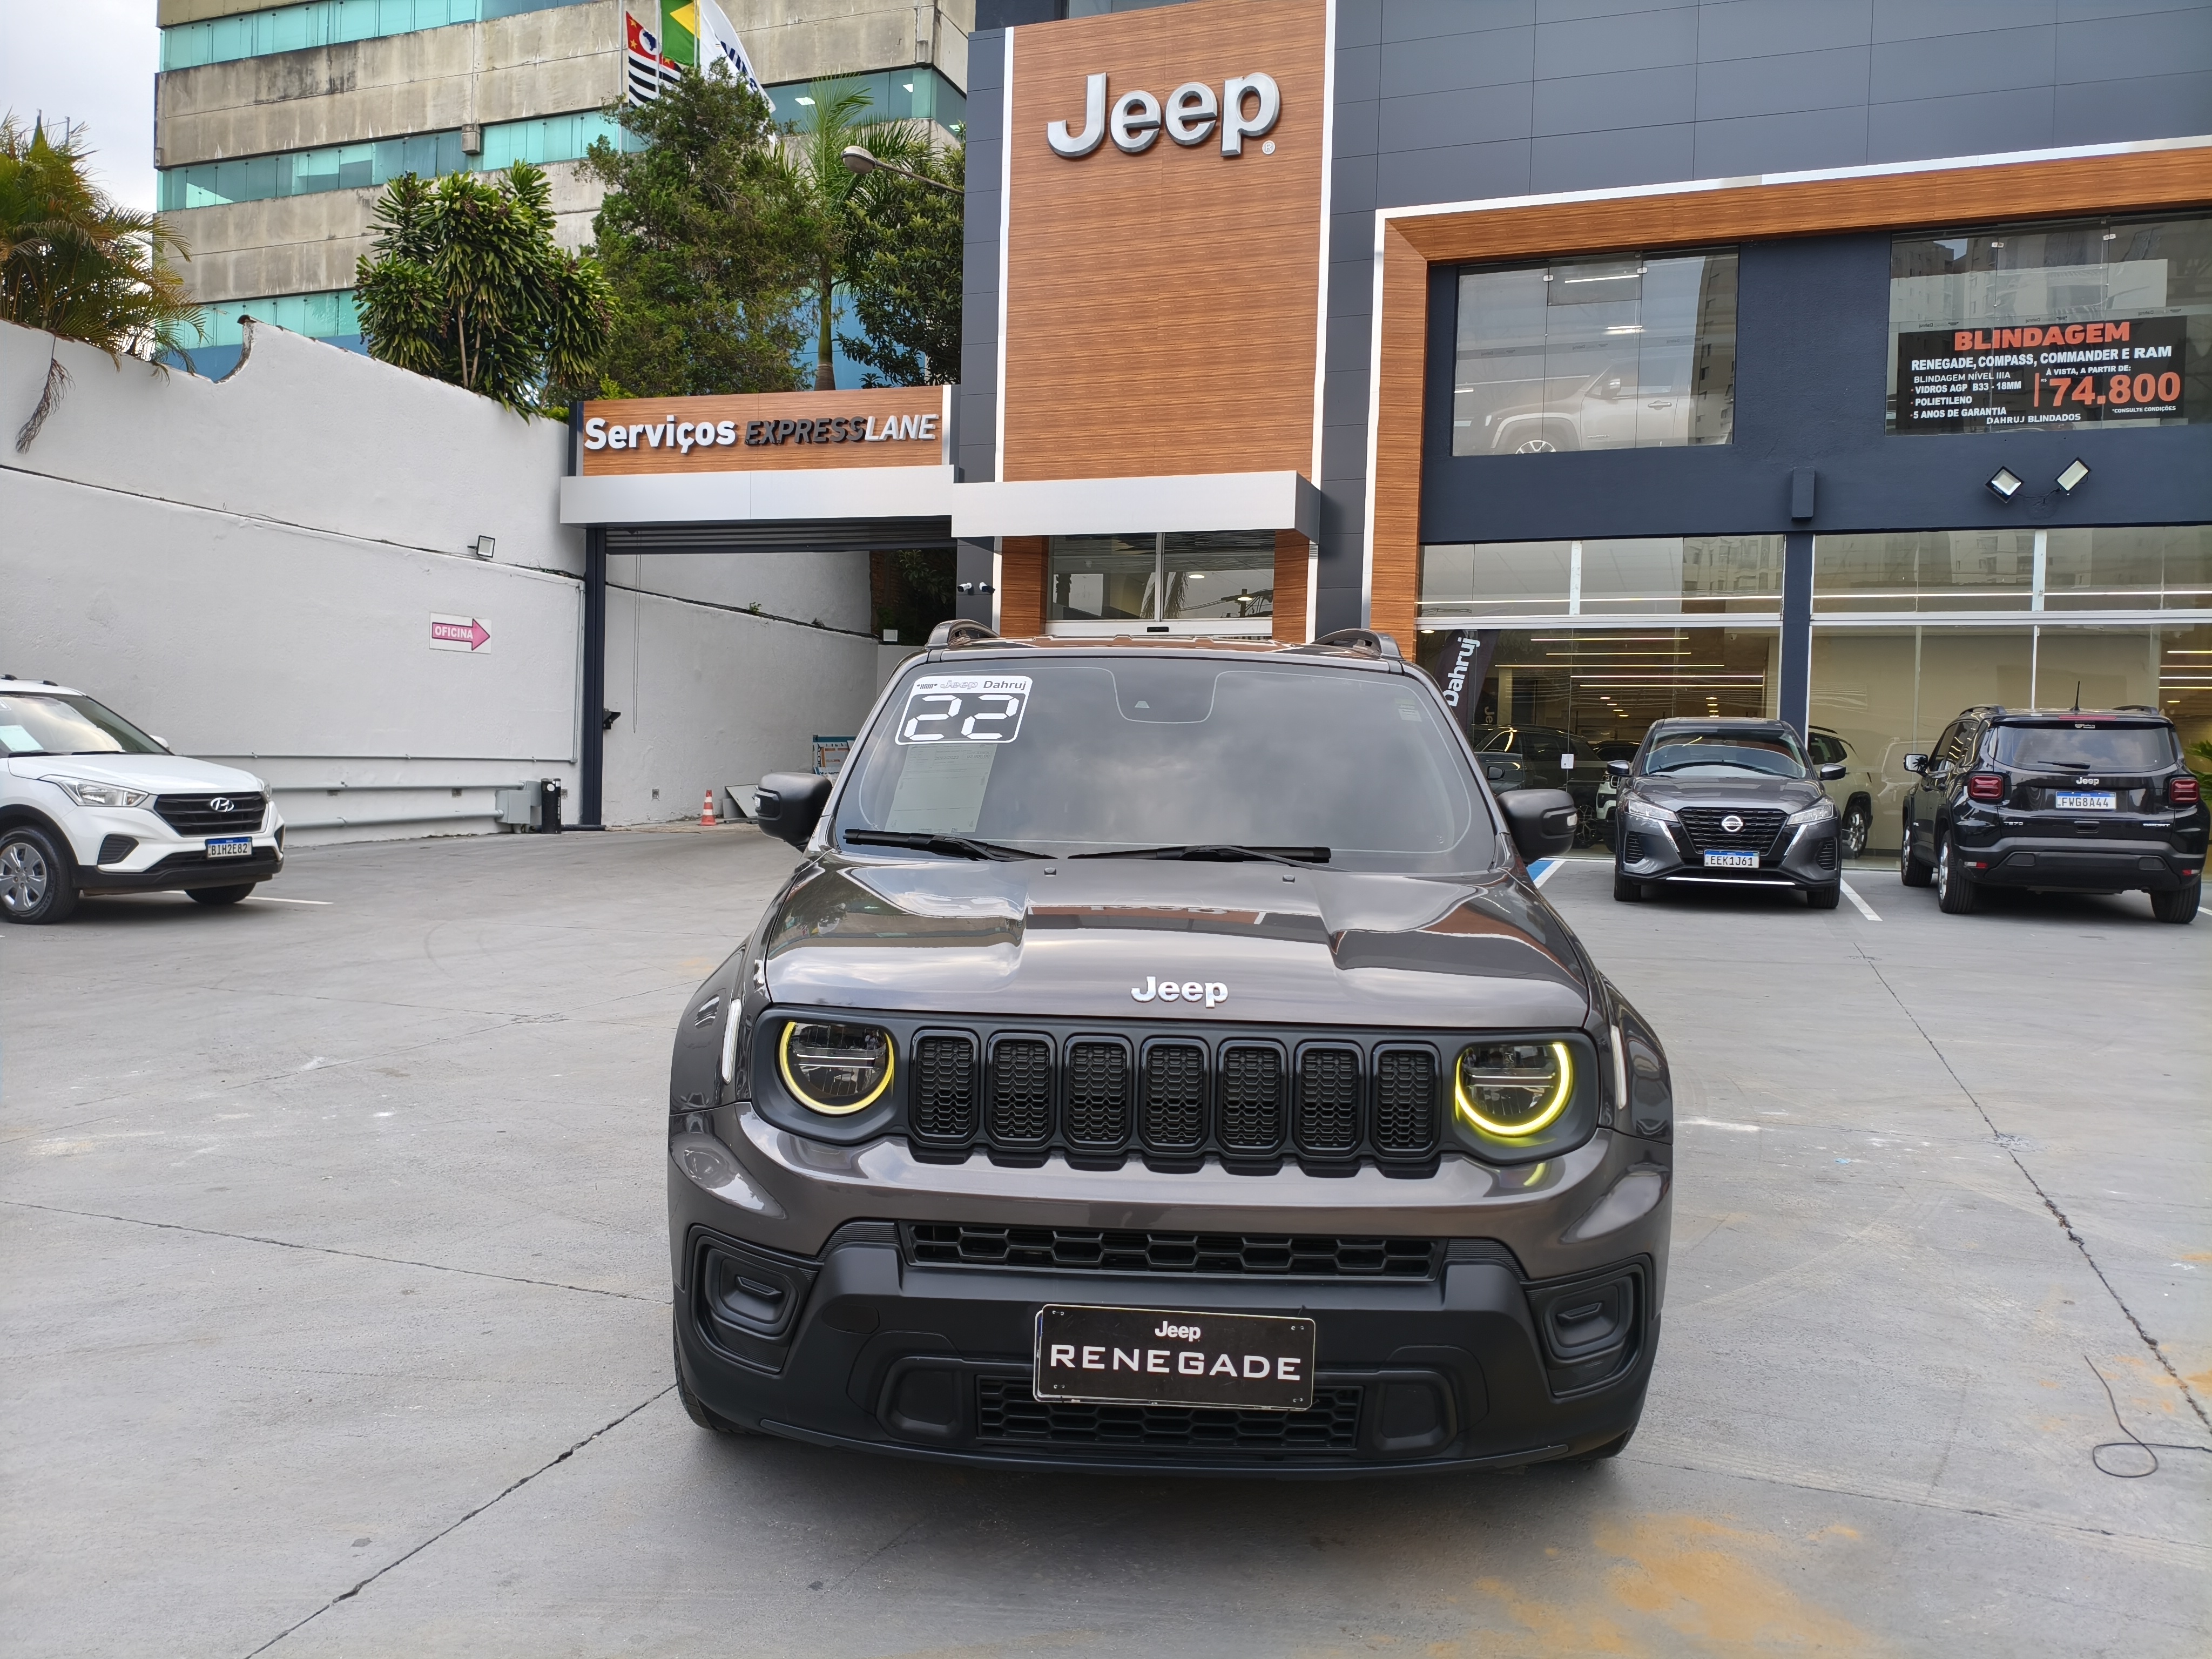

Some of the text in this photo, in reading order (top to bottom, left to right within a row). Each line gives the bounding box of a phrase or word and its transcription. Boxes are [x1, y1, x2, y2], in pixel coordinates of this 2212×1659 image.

[1046, 71, 1280, 158] Jeep
[1954, 322, 2130, 351] BLINDAGEM
[1911, 346, 2172, 370] RENEGADE, COMPASS, COMMANDER E RAM
[1914, 374, 1966, 383] BLINDAGEM
[1968, 371, 1994, 381] NÍVEL
[2046, 368, 2052, 376] À
[1915, 385, 1947, 394] VIDROS
[1950, 383, 1968, 392] AGP
[1972, 383, 1988, 391] B33
[1996, 381, 2021, 390] 18MM
[2049, 372, 2181, 407] 74.800
[1915, 395, 1972, 406] POLIETILENO
[1913, 407, 2007, 419] 5 ANOS DE GARANTIA
[1986, 413, 2081, 424] DAHRUJ BLINDADOS
[584, 415, 736, 454] Serviços
[435, 625, 474, 639] OFICINA
[1442, 637, 1480, 707] Dahruj
[940, 680, 1027, 691] Jeep Dahruj
[903, 694, 1020, 741] 22
[2076, 777, 2100, 786] Jeep
[2061, 797, 2109, 807] FWG8A44
[211, 843, 247, 855] BIH2E82
[1710, 855, 1753, 866] EEK1J61
[1131, 976, 1229, 1009] Jeep
[1155, 1320, 1201, 1342] Jeep
[1050, 1344, 1301, 1381] RENEGADE
